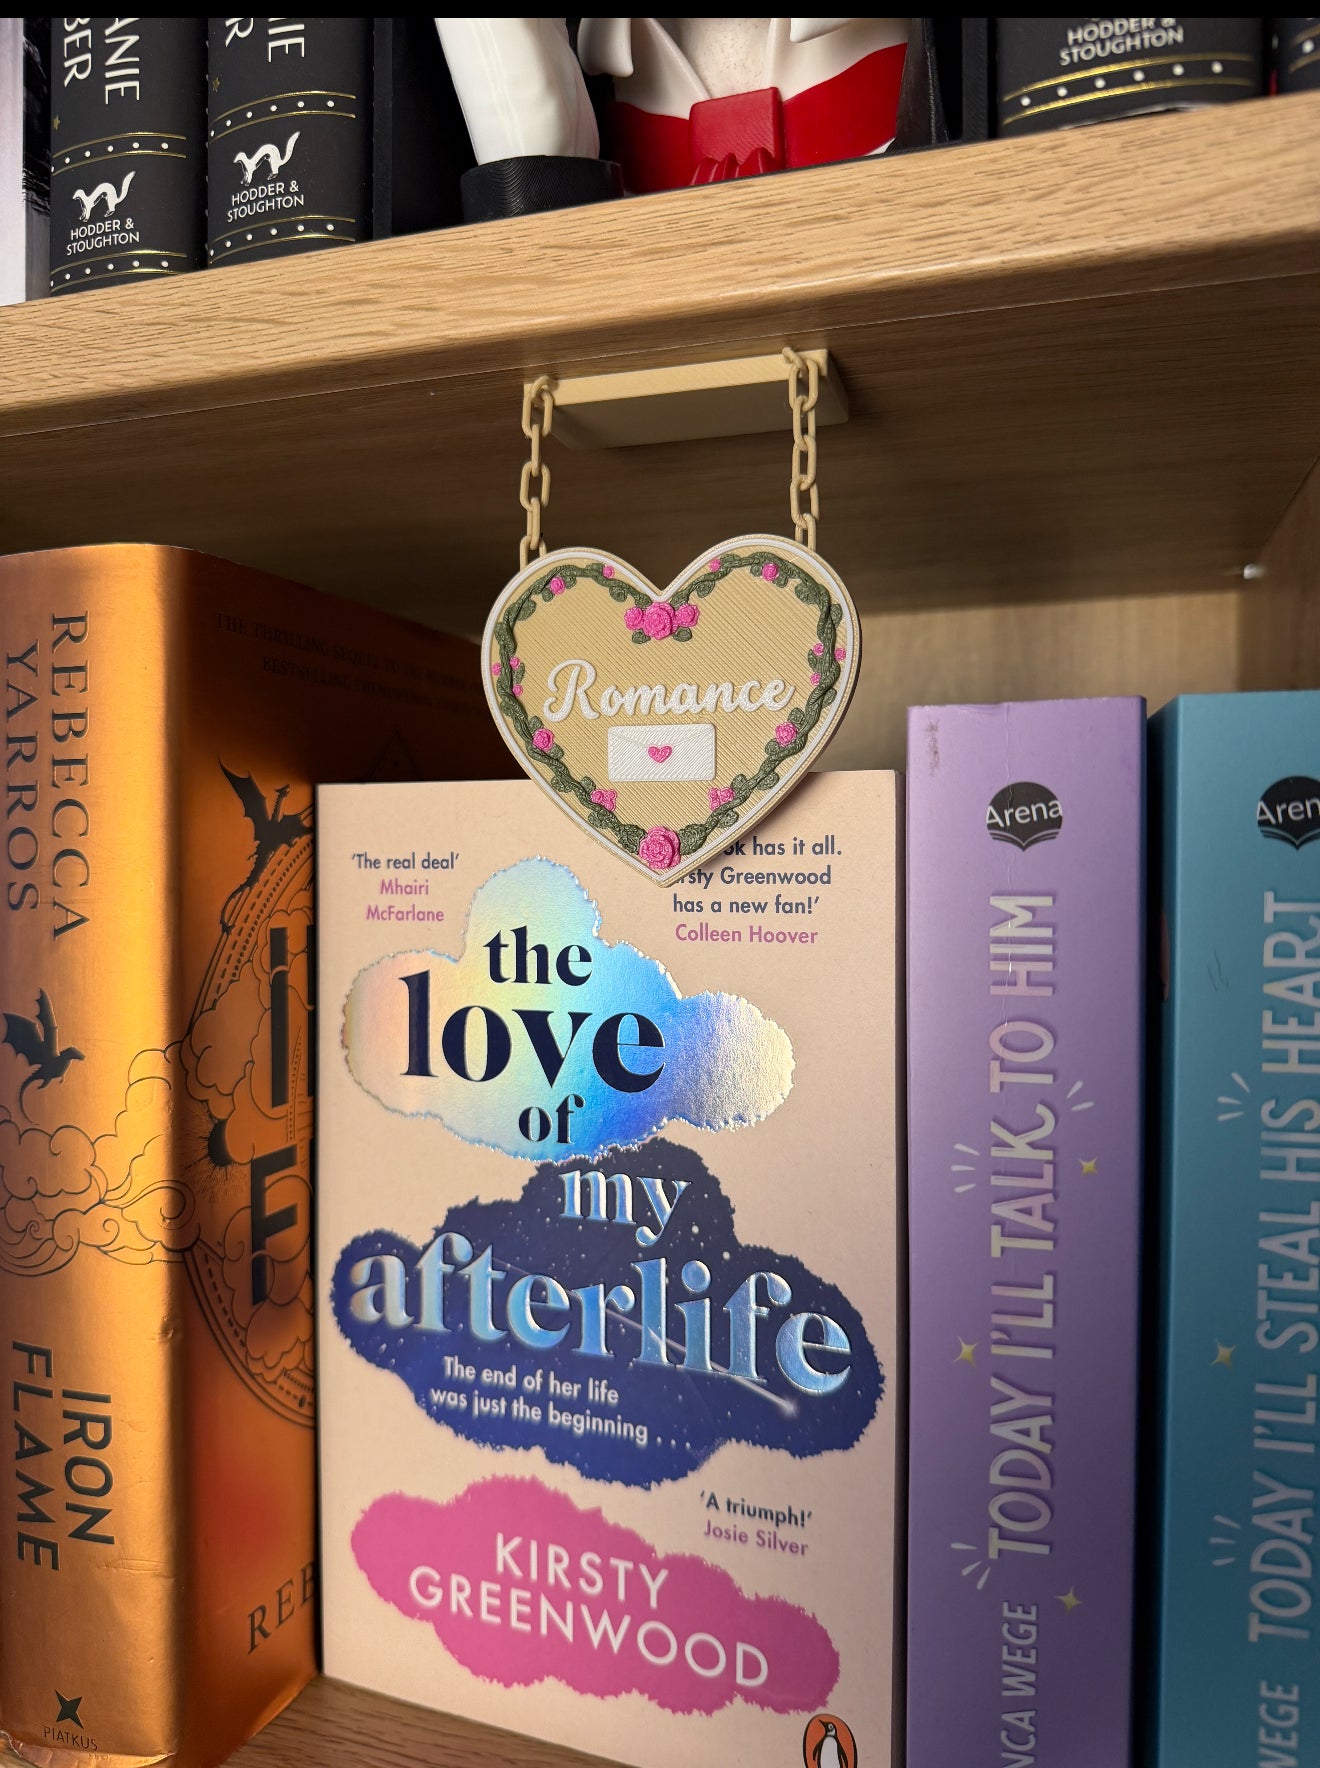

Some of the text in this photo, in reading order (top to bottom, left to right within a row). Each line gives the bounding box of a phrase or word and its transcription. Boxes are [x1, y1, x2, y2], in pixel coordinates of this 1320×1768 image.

[268, 17, 305, 63] IE
[1059, 24, 1184, 66] STOUGHTON
[1066, 17, 1156, 46] HODDER
[227, 194, 304, 222] STOUGHTON
[231, 180, 299, 207] HODDER &
[66, 231, 140, 256] STOUGHTON
[70, 217, 135, 241] HODDER &
[543, 659, 796, 723] Romance
[7, 639, 40, 912] YARROS
[51, 610, 90, 942] REBECCA
[985, 800, 1062, 829] Arena
[386, 852, 416, 869] real
[720, 864, 832, 885] Greenwood
[753, 836, 785, 856] has
[793, 837, 805, 856] it
[811, 835, 842, 856] all.
[366, 904, 445, 922] McFarlane
[380, 878, 429, 895] Mhairi
[673, 893, 703, 913] has
[710, 901, 722, 913] a
[729, 901, 768, 914] new
[483, 925, 593, 987] the
[675, 922, 819, 944] Colleen Hoover
[989, 895, 1054, 997] HIM
[1261, 890, 1320, 1074] HEART
[398, 969, 667, 1094] love
[989, 1020, 1056, 1093] TO
[518, 1093, 586, 1145] of
[1260, 1098, 1320, 1182] HIS
[558, 1168, 693, 1248] my
[989, 1103, 1056, 1258] TALK
[1255, 1200, 1320, 1354] STEAL
[349, 1231, 853, 1396] afterlife
[443, 1355, 619, 1405] The end of her life
[430, 1388, 468, 1408] was
[471, 1389, 507, 1417] just
[511, 1394, 542, 1421] the
[547, 1402, 649, 1445] beginning
[12, 1340, 60, 1571] FLAME
[62, 1388, 115, 1545] IRON
[988, 1375, 1053, 1559] TODAY
[703, 1519, 809, 1556] Josie Silver
[1247, 1470, 1315, 1643] TODAY
[496, 1532, 670, 1610] KIRSTY
[409, 1564, 769, 1688] GREENWOOD
[1001, 1601, 1038, 1697] WEGE
[43, 1725, 98, 1752] PIATKUS
